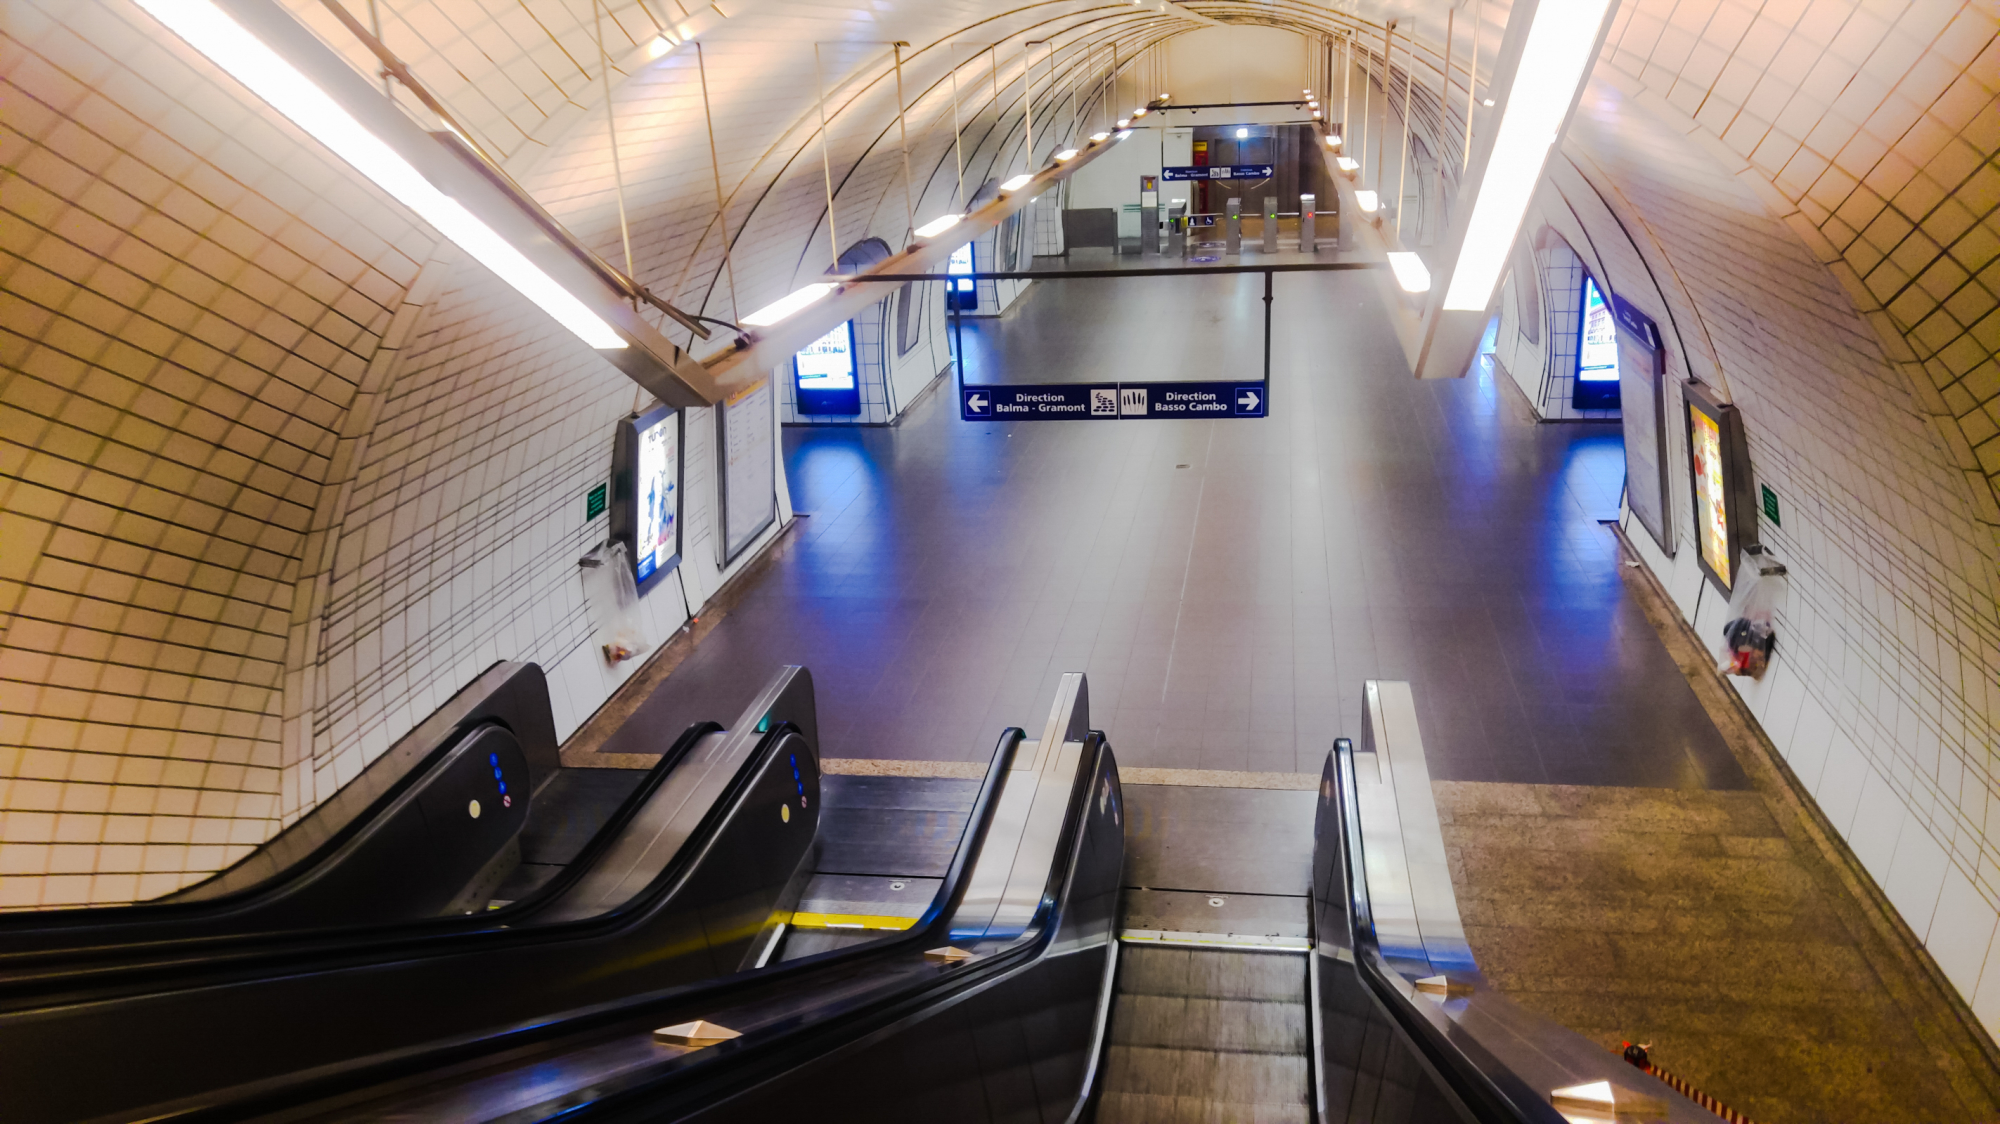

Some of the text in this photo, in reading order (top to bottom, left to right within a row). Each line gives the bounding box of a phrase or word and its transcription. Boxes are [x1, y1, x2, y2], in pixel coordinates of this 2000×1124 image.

[1016, 393, 1065, 402] Direction
[1166, 391, 1216, 401] Direction
[996, 403, 1029, 412] Balma
[1038, 403, 1086, 412] Gramont
[1155, 401, 1228, 412] Basso Cambo
